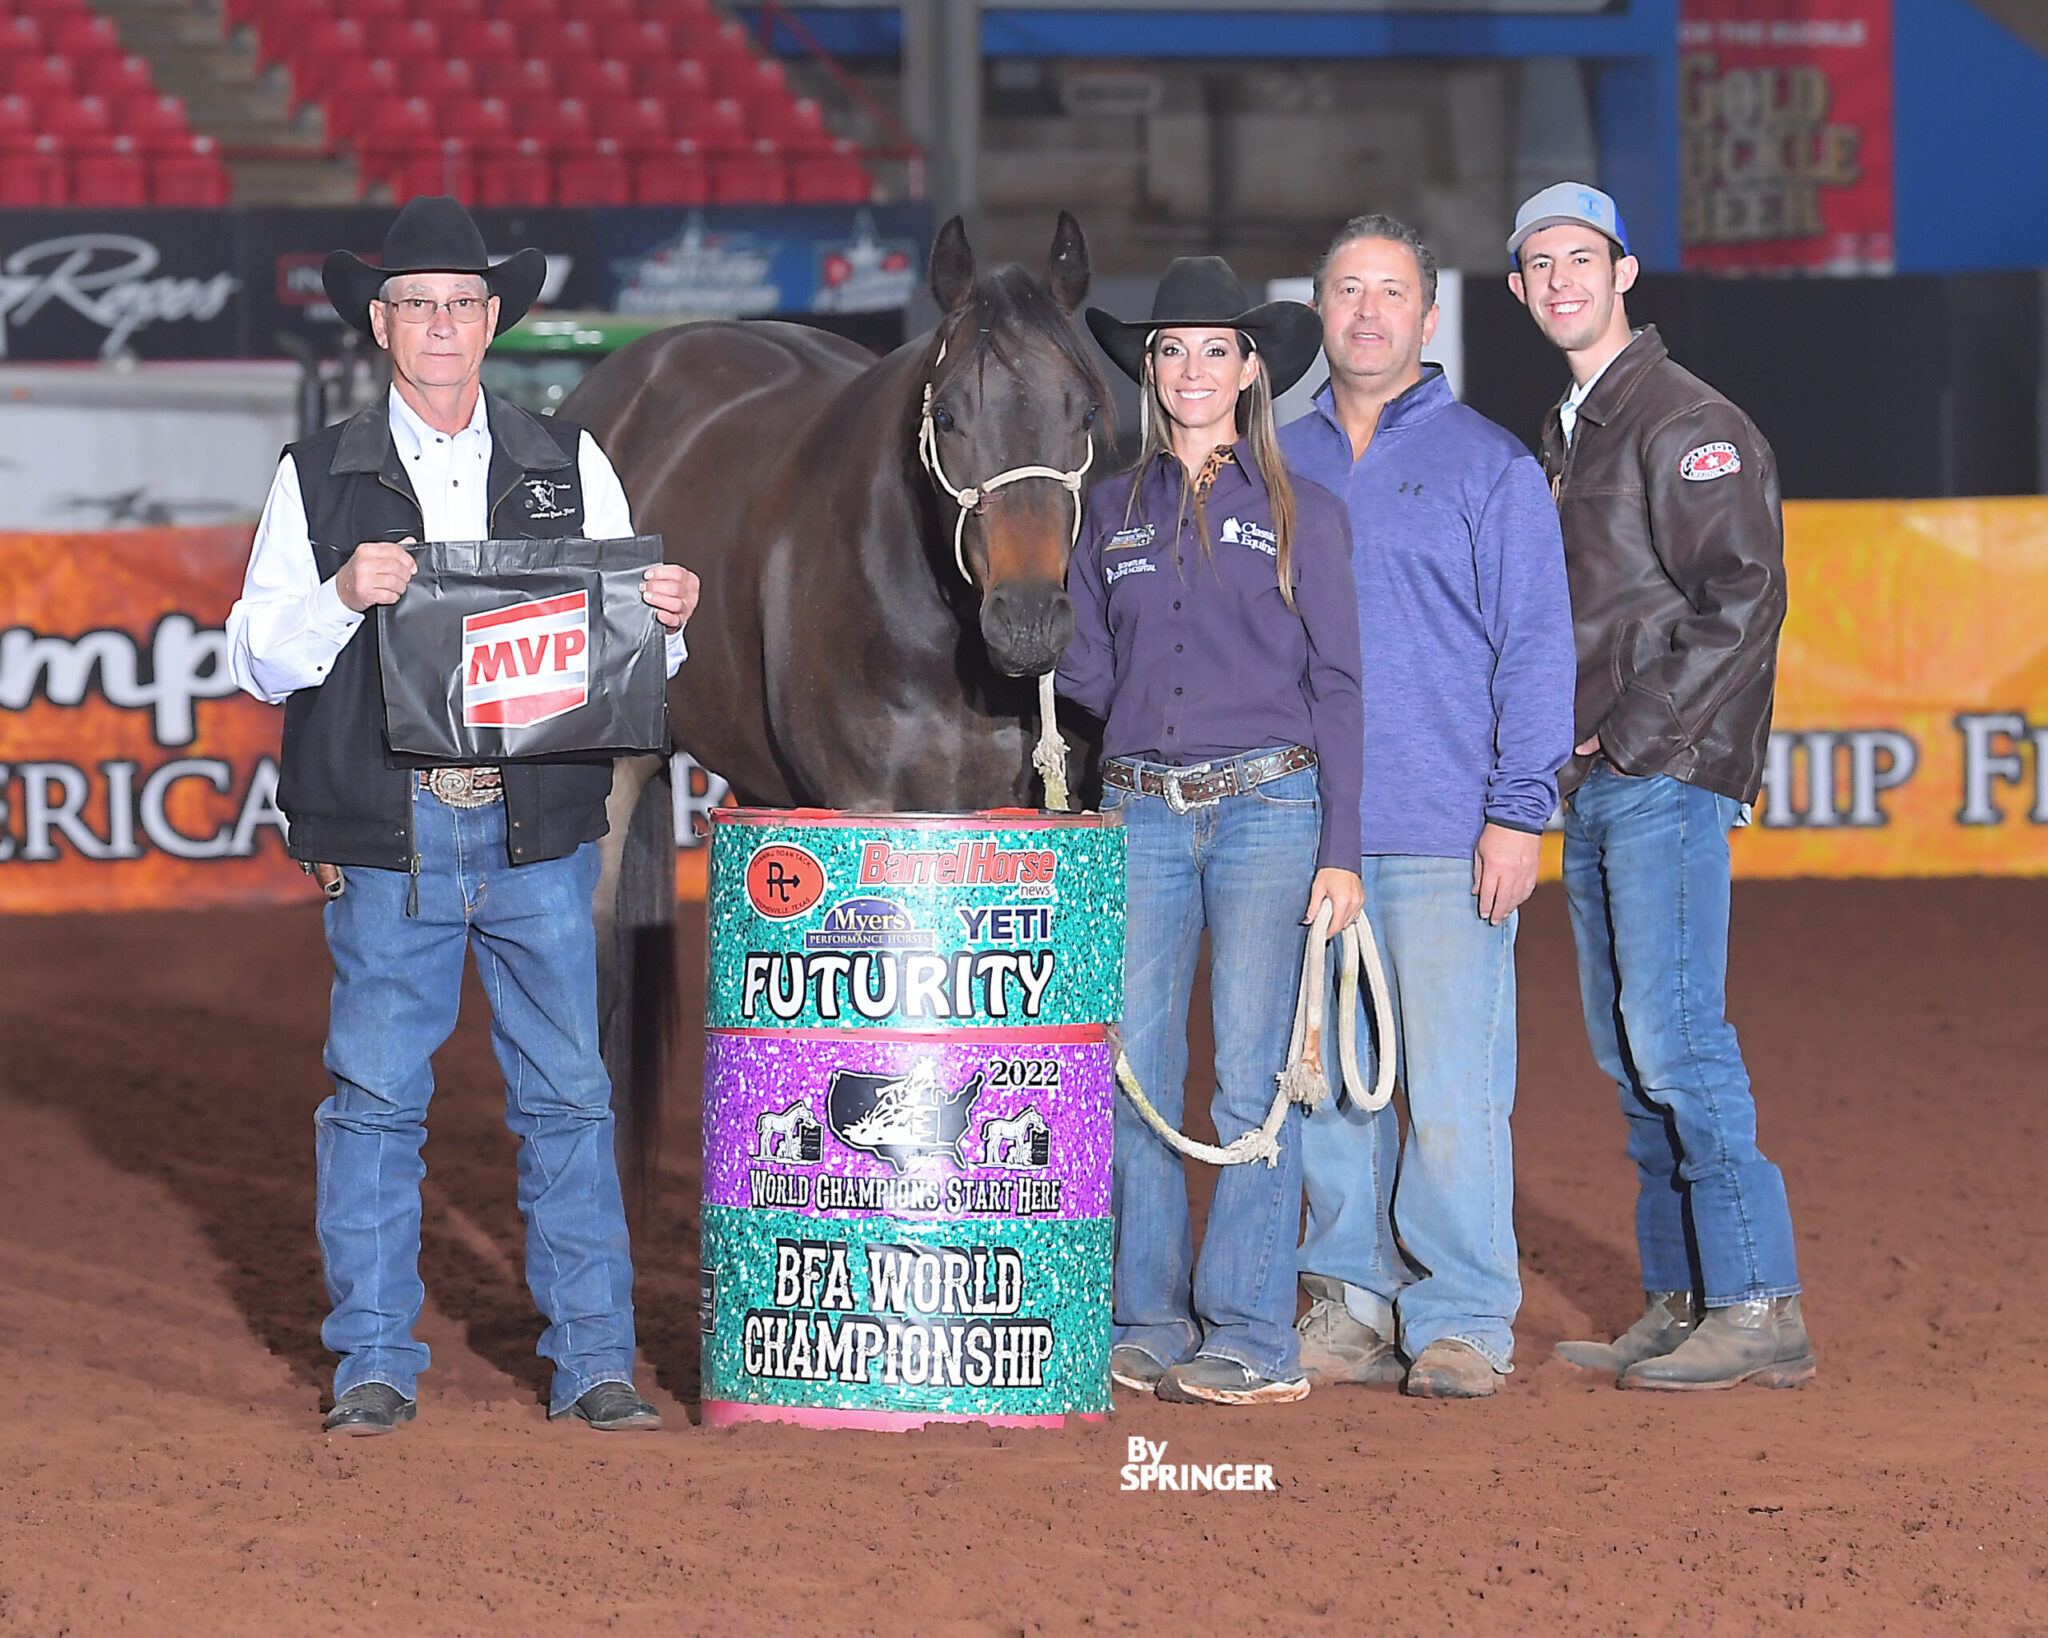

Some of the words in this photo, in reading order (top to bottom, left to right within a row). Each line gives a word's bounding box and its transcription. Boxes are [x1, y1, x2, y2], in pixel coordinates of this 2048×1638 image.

[1240, 533, 1277, 556] Equine
[466, 629, 586, 687] MVP
[1020, 885, 1051, 897] news
[834, 906, 906, 936] Myers
[959, 907, 1048, 940] YETI
[809, 934, 885, 945] PERFORMANCE
[887, 934, 930, 944] HORSES
[741, 950, 1056, 1021] FUTURITY
[988, 1060, 1060, 1087] 2022
[750, 1168, 811, 1210] WORLD
[814, 1172, 941, 1212] CHAMPIONS
[945, 1175, 1014, 1214] START
[1016, 1176, 1062, 1215] HERE
[775, 1238, 855, 1313] BFA
[866, 1243, 1025, 1316] WORLD
[742, 1308, 1055, 1389] CHAMPIONSHIP
